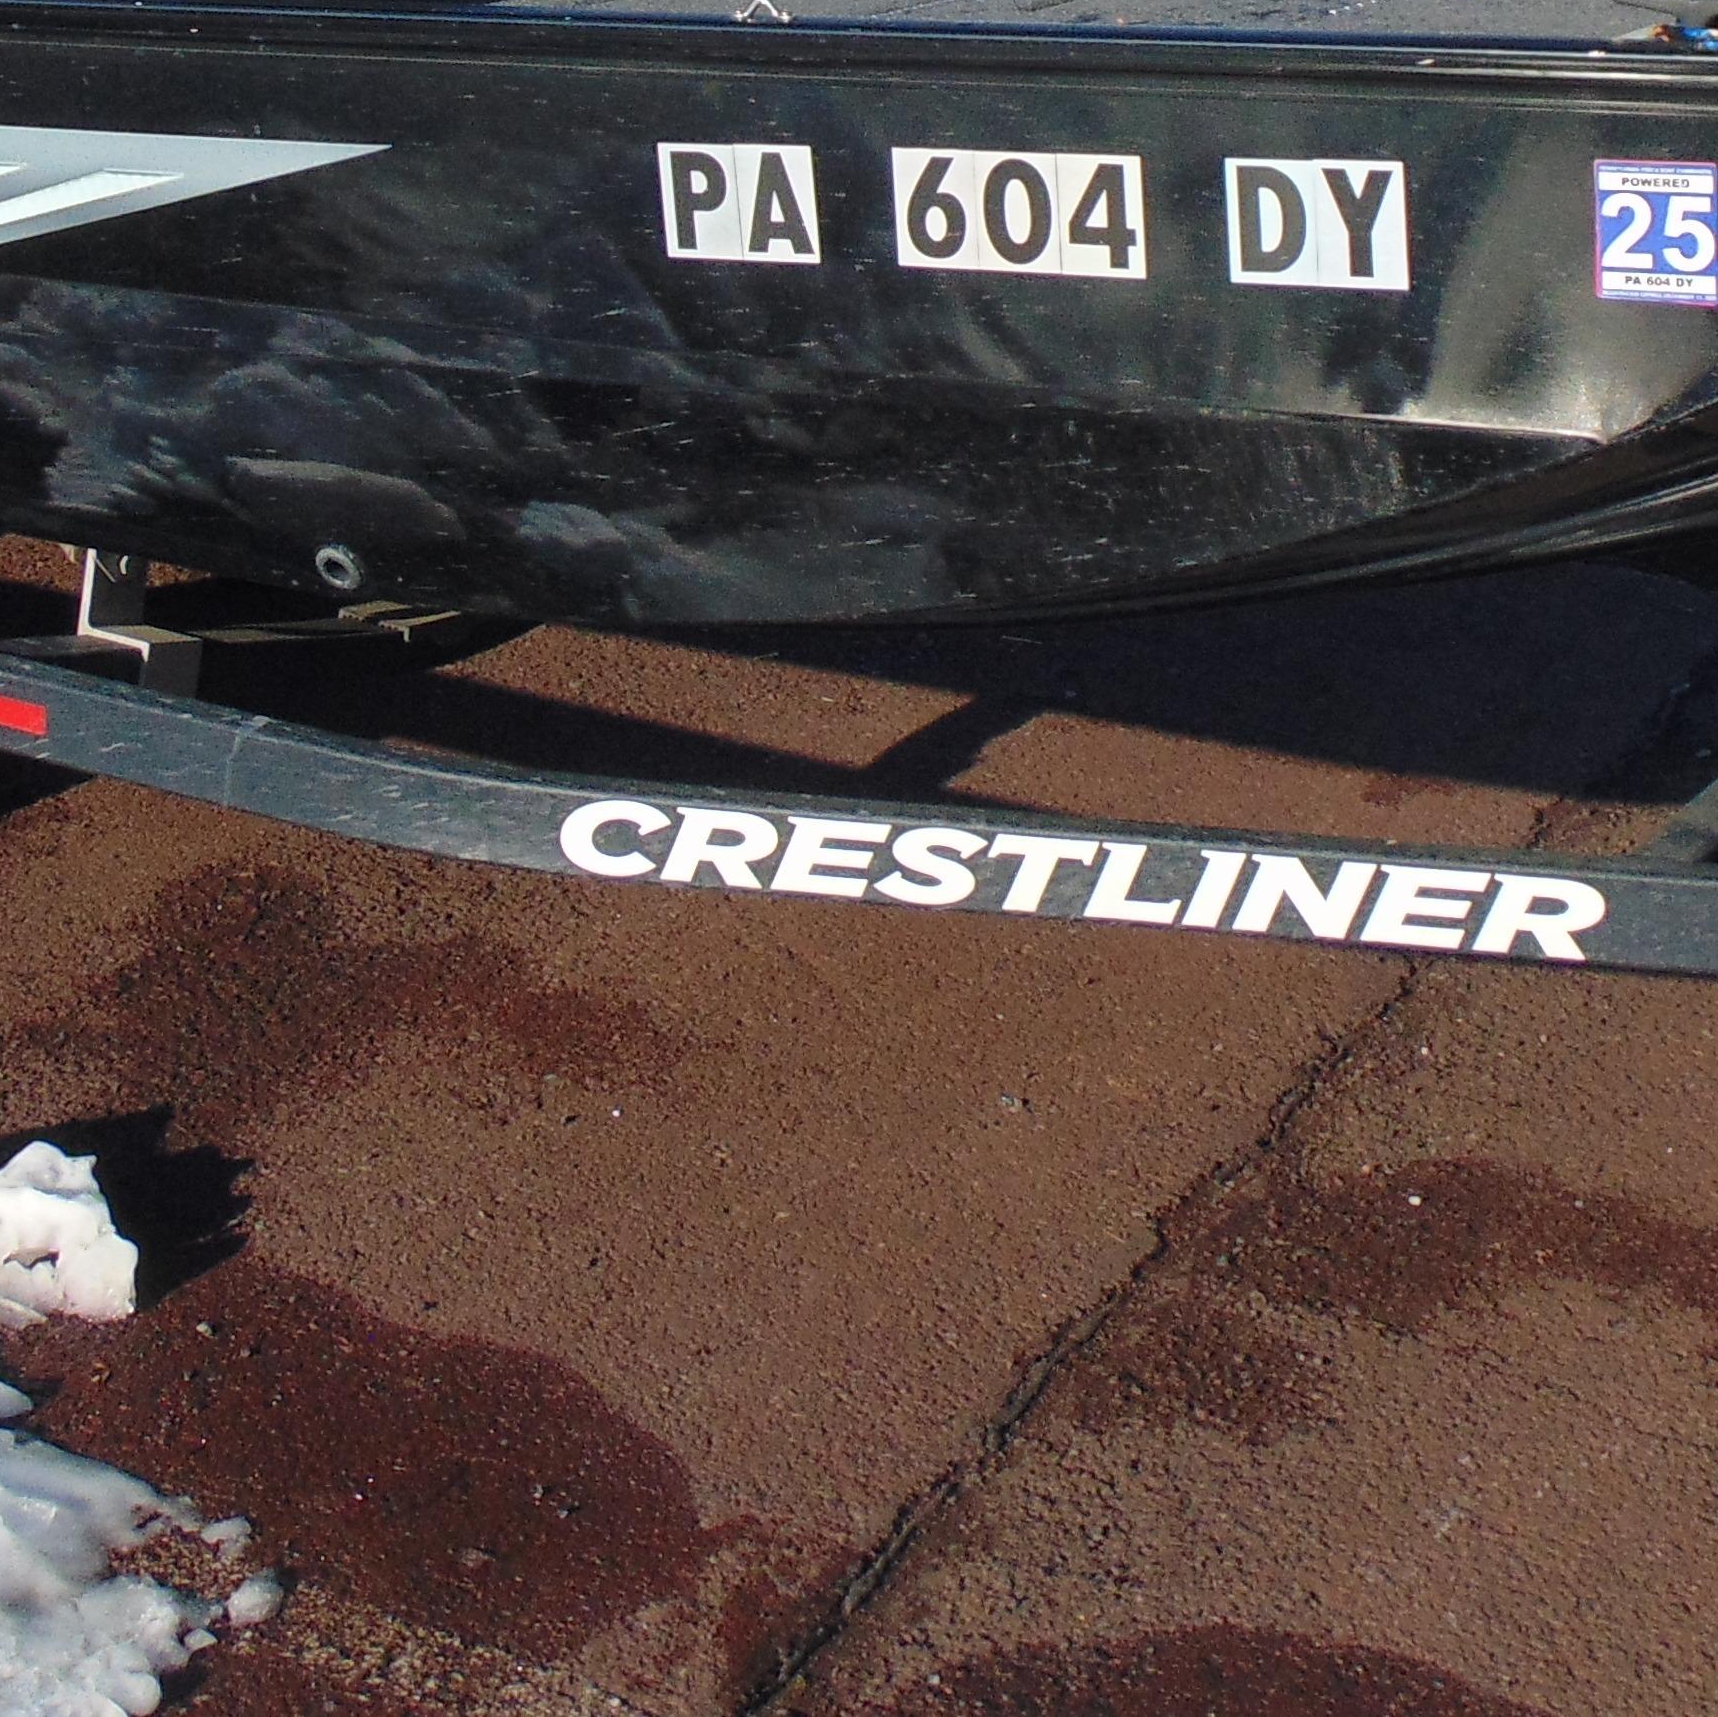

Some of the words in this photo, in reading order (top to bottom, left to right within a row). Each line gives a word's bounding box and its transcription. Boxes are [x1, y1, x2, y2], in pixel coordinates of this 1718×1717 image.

[669, 149, 817, 257] PA
[905, 155, 1139, 272] 604
[1234, 164, 1395, 279] DY
[1621, 176, 1691, 188] POWERED
[1600, 192, 1716, 273] 25
[1624, 275, 1642, 286] PA
[1646, 276, 1671, 287] 604
[1676, 278, 1694, 288] DY
[558, 797, 1609, 962] CRESTLINER
